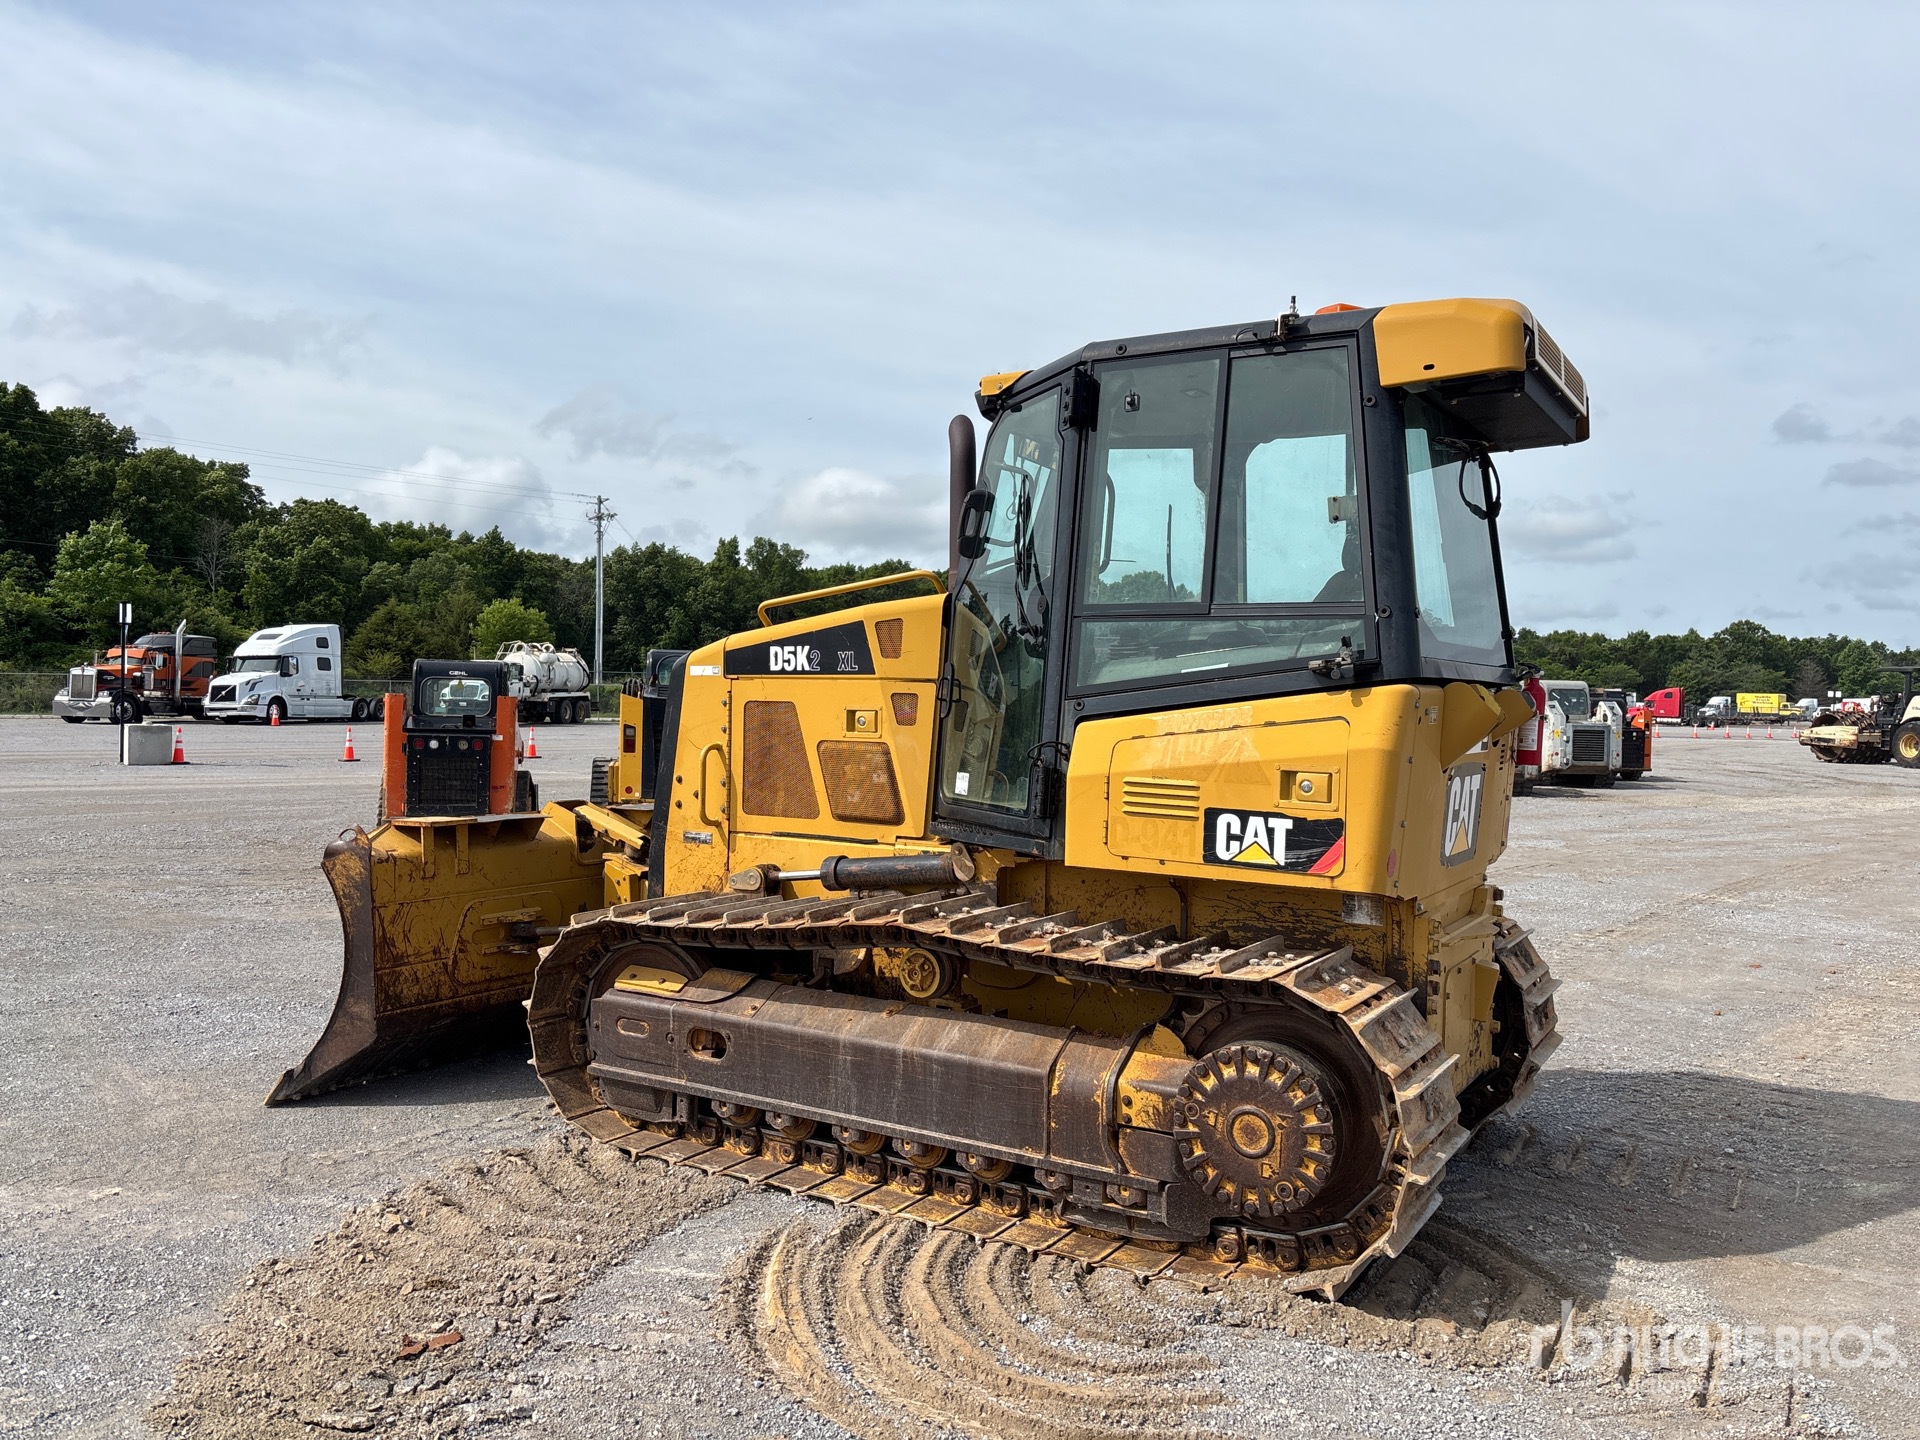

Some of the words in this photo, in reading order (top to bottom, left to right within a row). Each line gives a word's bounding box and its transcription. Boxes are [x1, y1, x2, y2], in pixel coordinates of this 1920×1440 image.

[837, 651, 859, 671] XL
[1215, 813, 1293, 866] CAT
[1444, 773, 1482, 857] CAT
